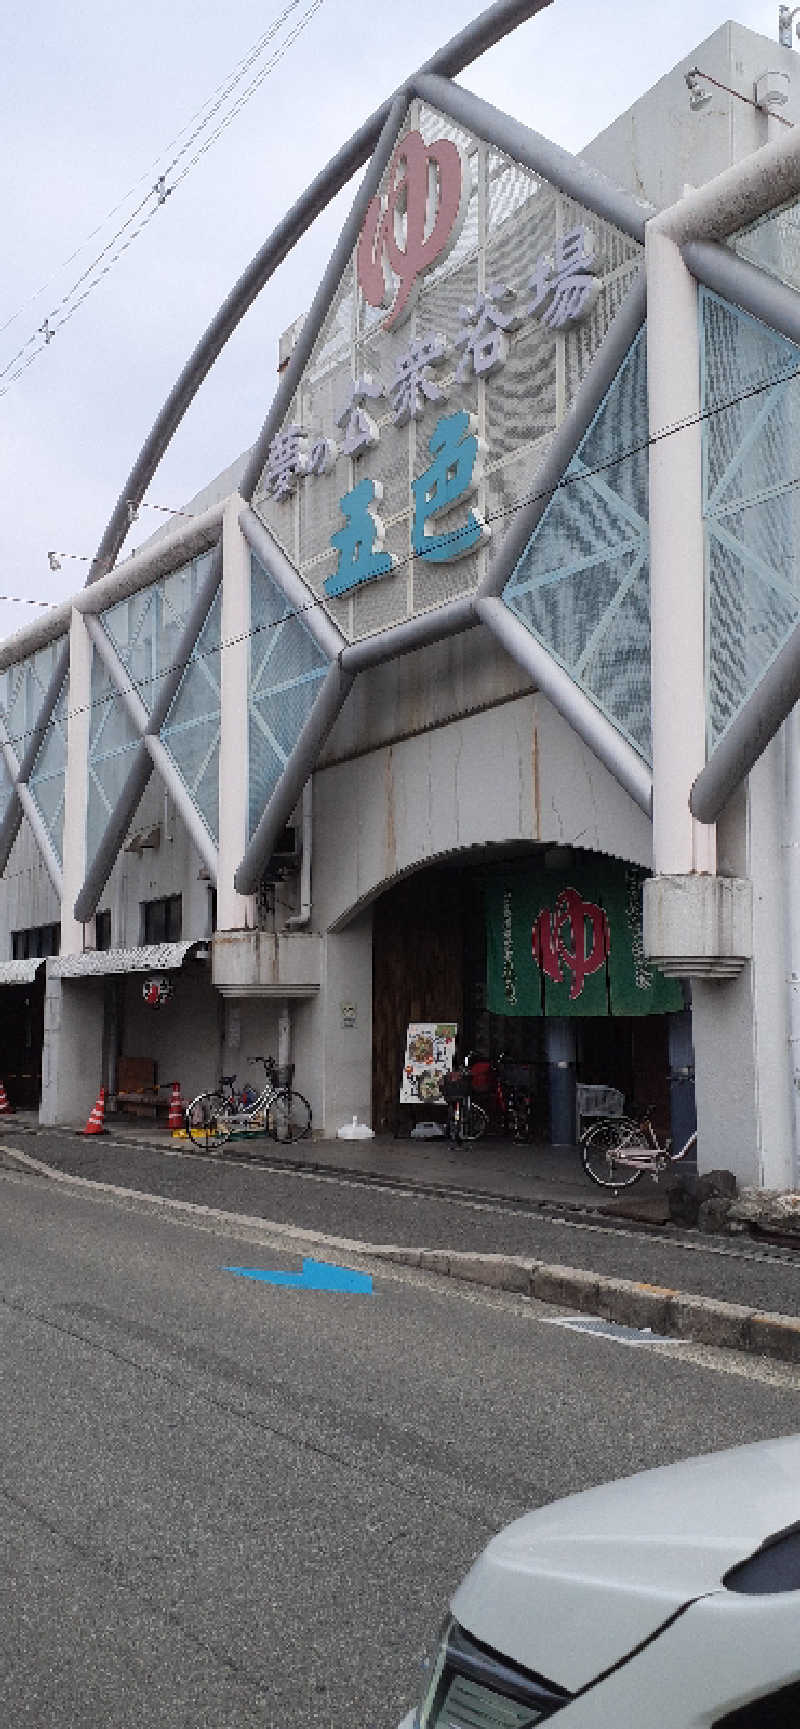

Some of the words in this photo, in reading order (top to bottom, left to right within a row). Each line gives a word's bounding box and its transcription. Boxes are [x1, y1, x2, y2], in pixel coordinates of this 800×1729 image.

[357, 129, 462, 331] ゆ
[264, 226, 599, 502] 夢の公衆浴場
[323, 409, 483, 597] 五色
[531, 886, 611, 999] ゆ
